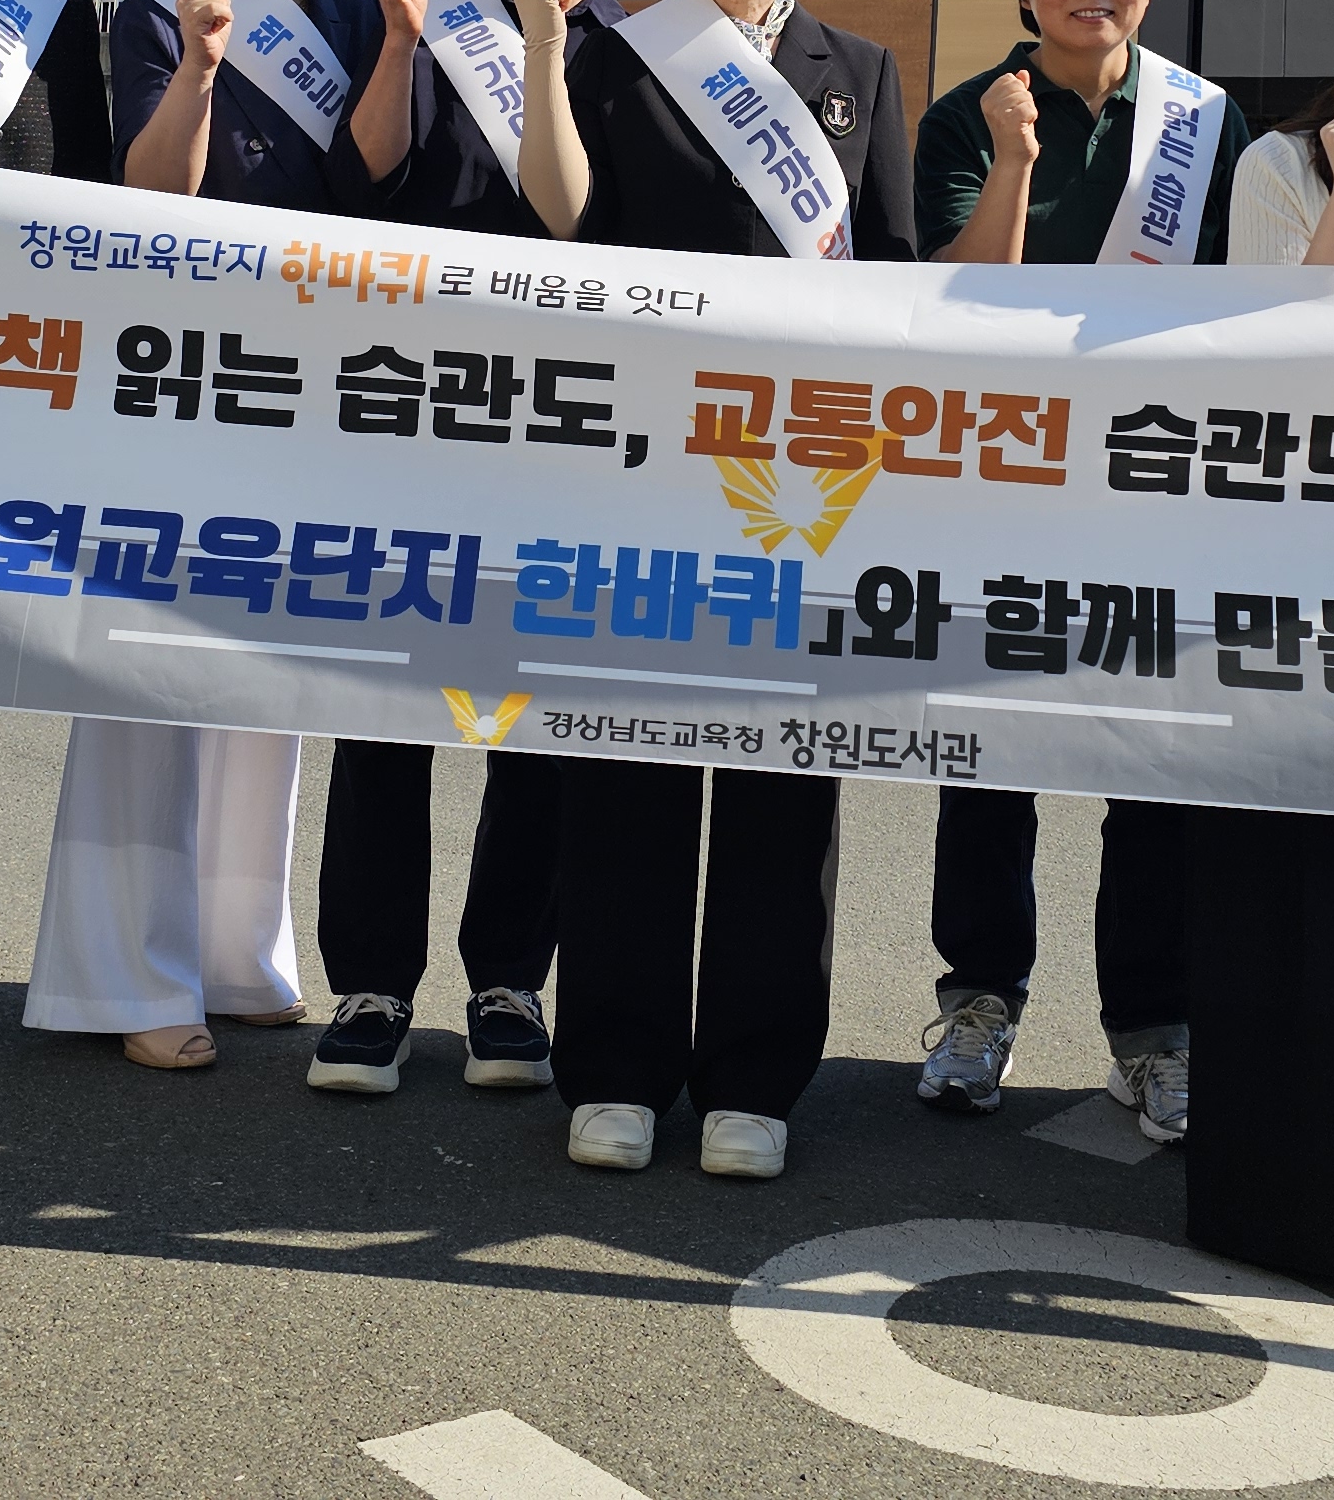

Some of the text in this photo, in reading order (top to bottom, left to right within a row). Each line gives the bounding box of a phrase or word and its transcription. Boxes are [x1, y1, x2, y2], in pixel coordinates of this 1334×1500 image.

[246, 14, 346, 118] 책 읽는
[438, 1, 499, 57] 책은
[1164, 66, 1202, 100] 책
[700, 61, 769, 130] 책은
[746, 118, 833, 224] 가까이
[1158, 101, 1200, 170] 읽는
[1140, 172, 1186, 247] 습관
[19, 220, 269, 283] 창원교육단지
[489, 270, 610, 313] 배움을
[625, 284, 711, 318] 잇다
[113, 323, 304, 429] 읽는
[334, 344, 650, 469] 습관도,
[684, 370, 1072, 487] 교통안전
[982, 573, 1177, 680] 함께
[542, 711, 983, 780] 경상남도교육청 창원도서관
